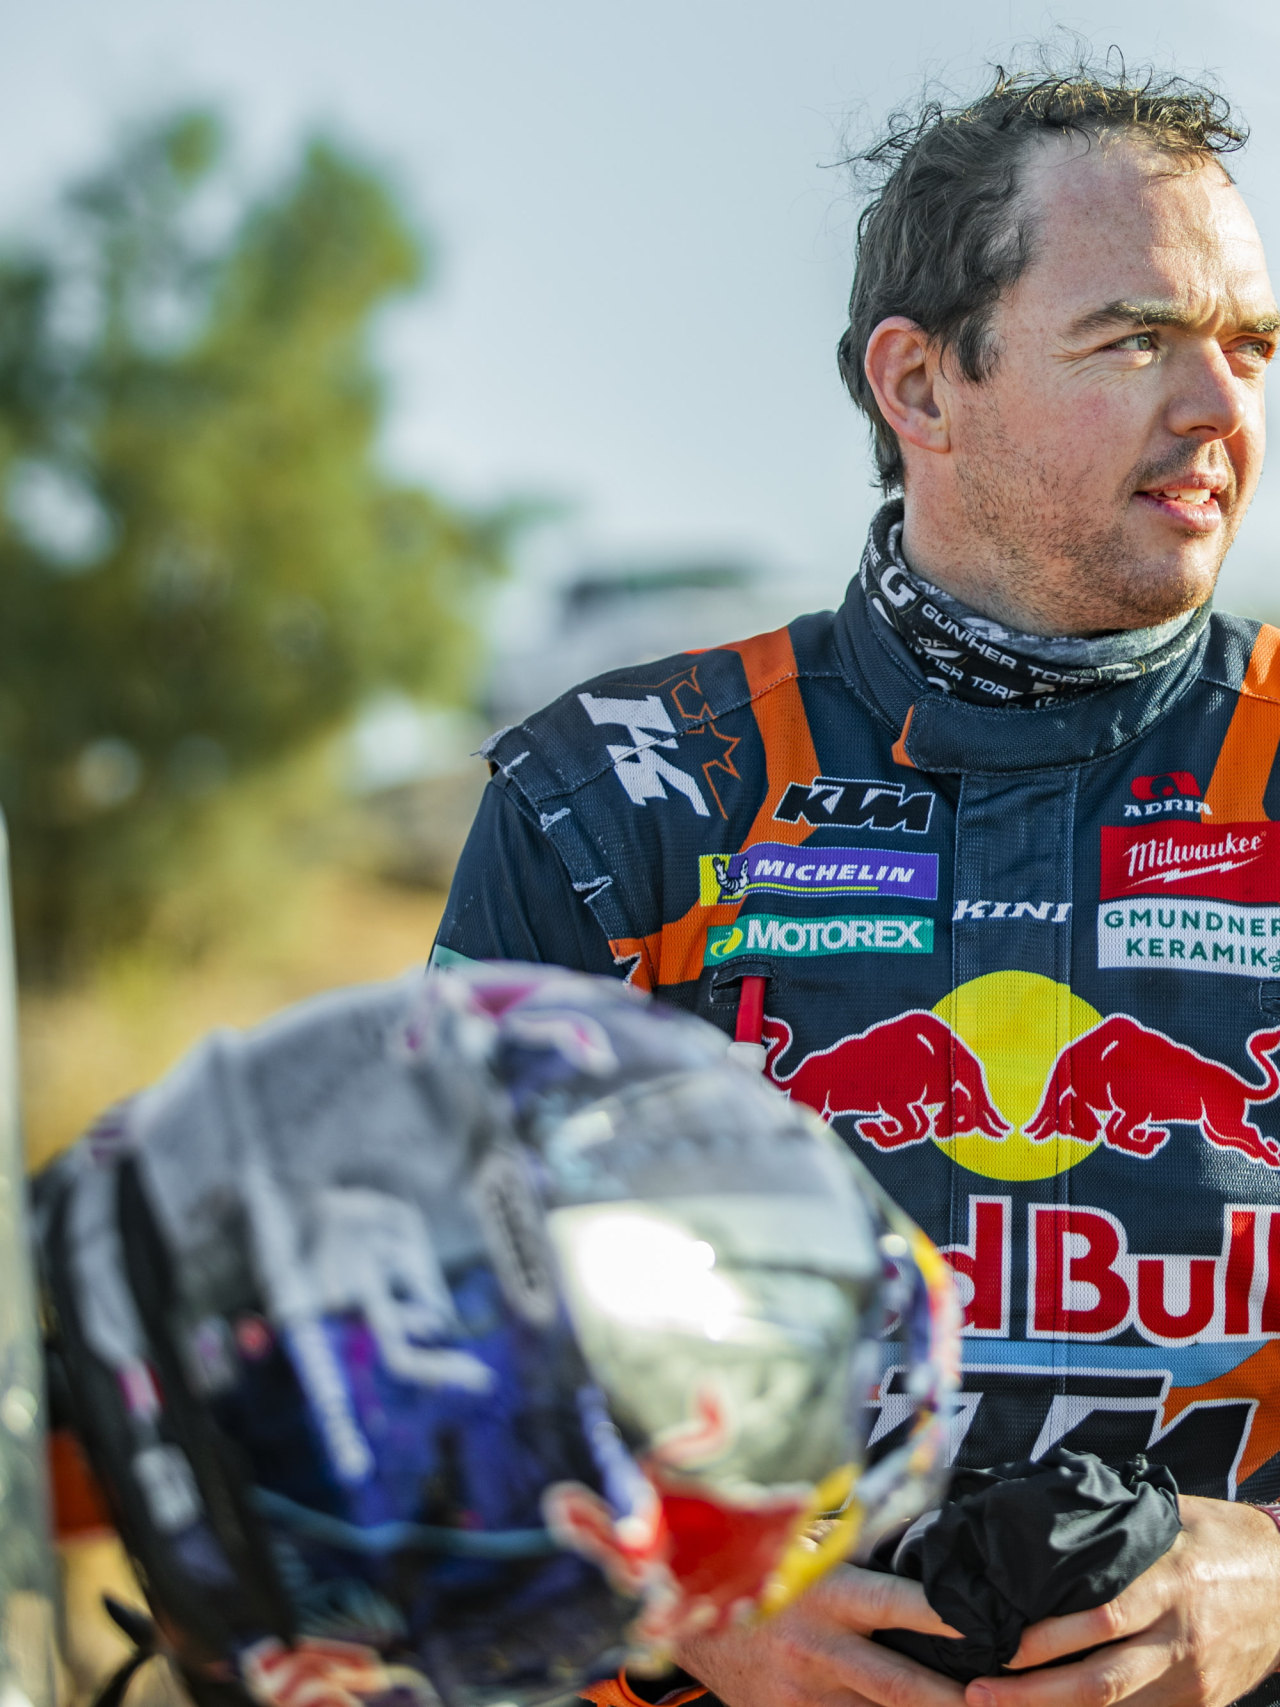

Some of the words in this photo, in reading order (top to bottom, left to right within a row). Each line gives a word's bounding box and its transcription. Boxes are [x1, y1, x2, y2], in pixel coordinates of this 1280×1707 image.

[772, 776, 937, 834] KTM
[1124, 799, 1213, 818] ADRIA
[1122, 831, 1264, 877] Milwaukee
[754, 859, 915, 883] MICHELIN
[952, 900, 1073, 923] KINI
[746, 919, 923, 952] MOTOREX
[1127, 938, 1269, 968] KERAMIK
